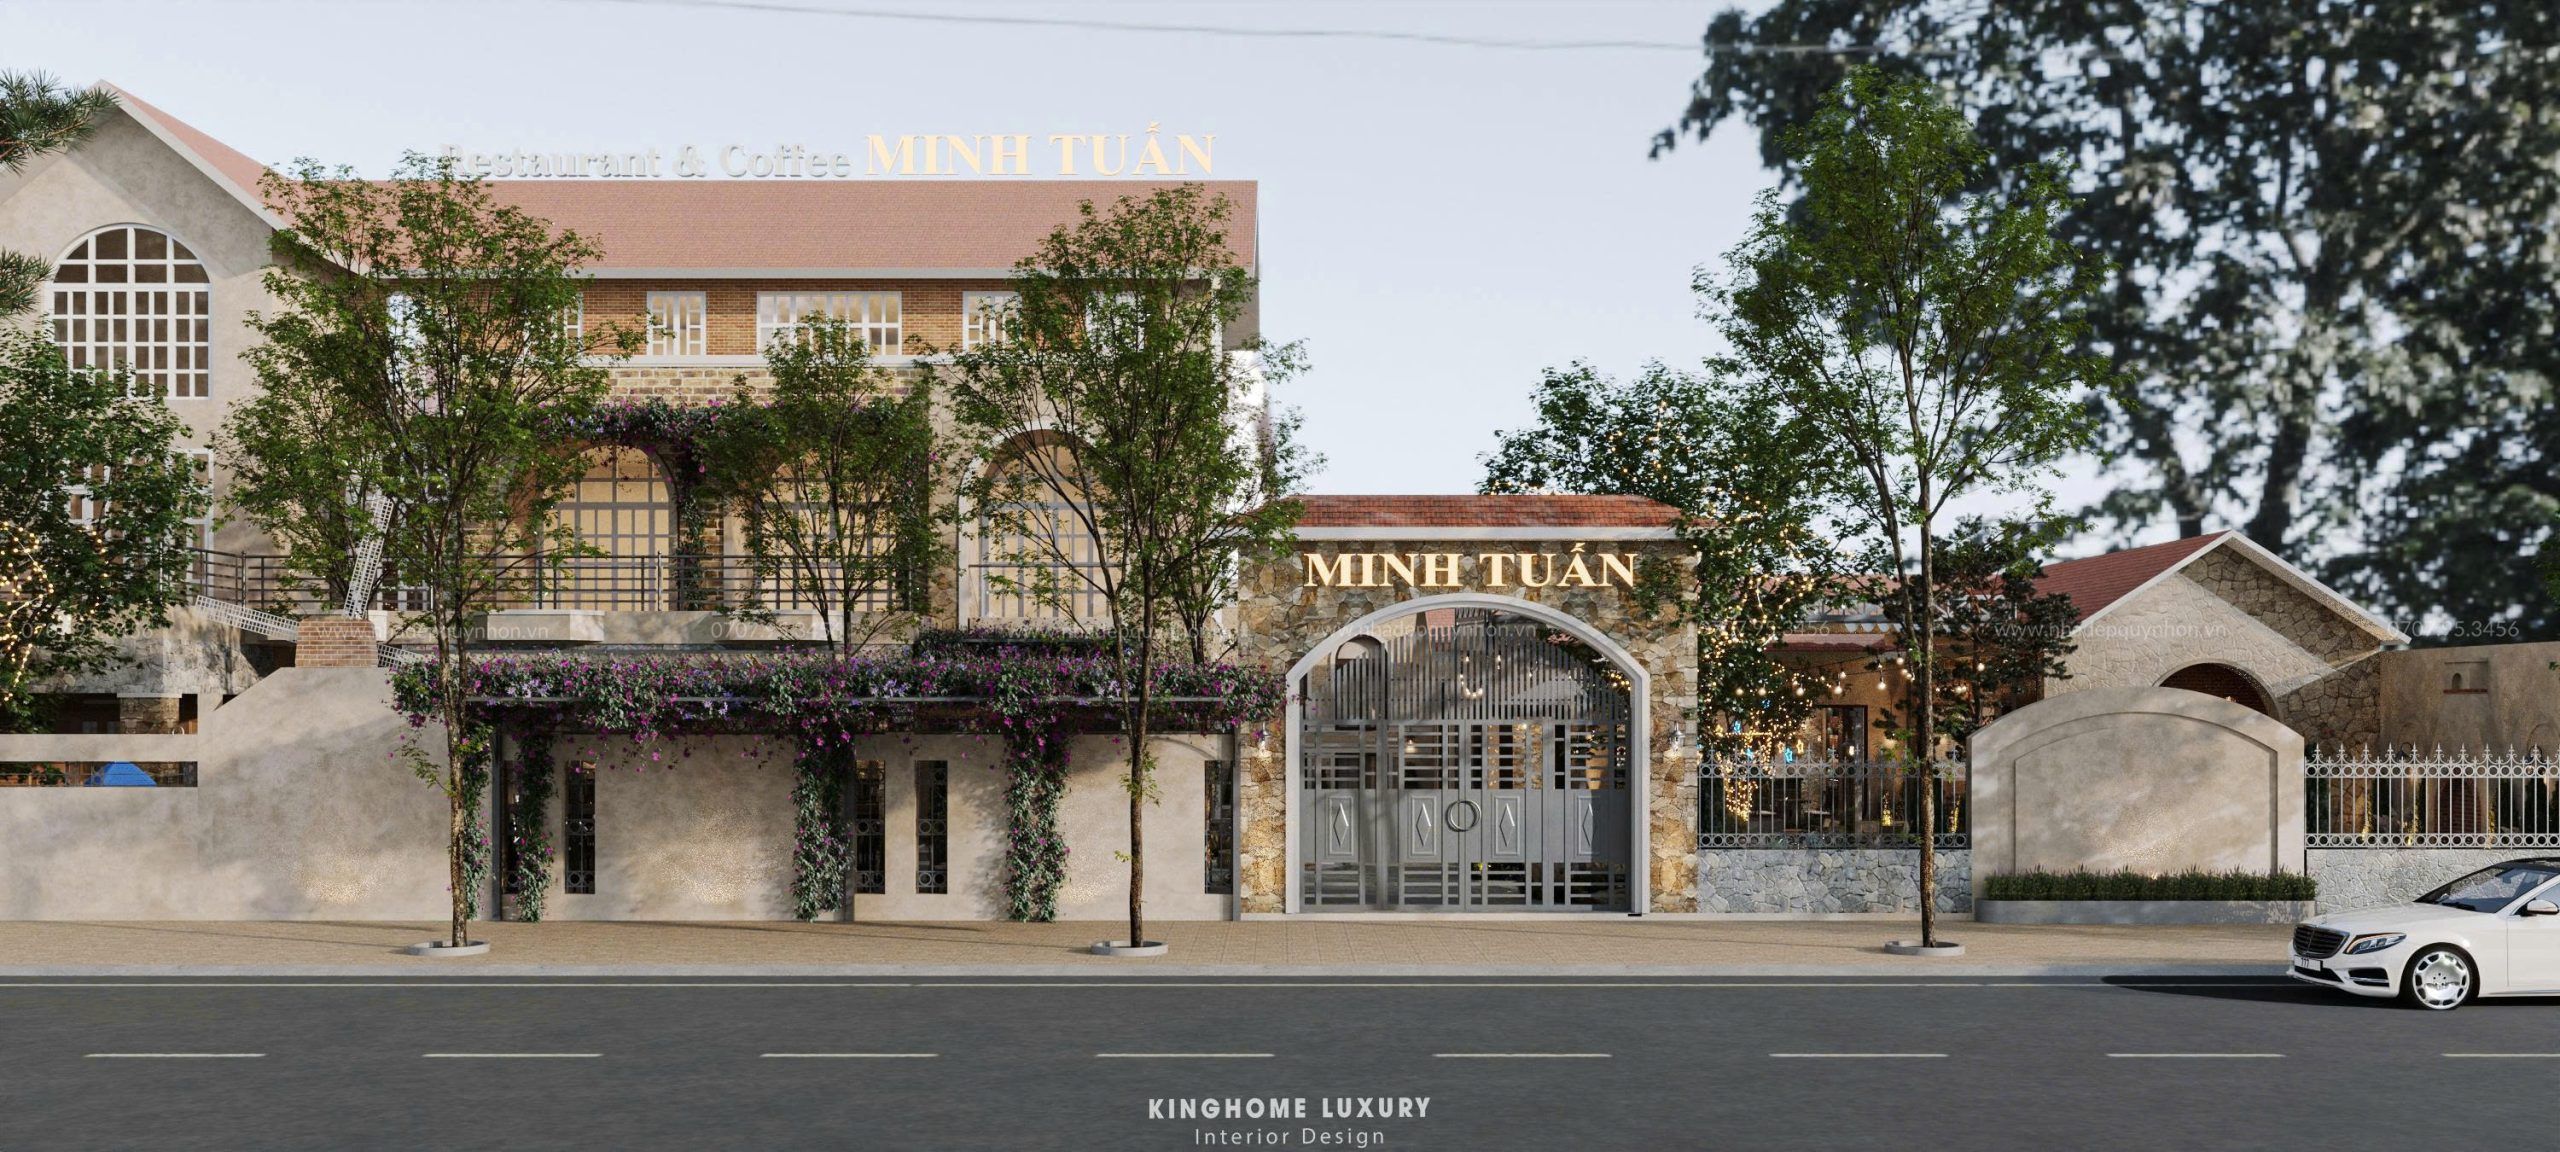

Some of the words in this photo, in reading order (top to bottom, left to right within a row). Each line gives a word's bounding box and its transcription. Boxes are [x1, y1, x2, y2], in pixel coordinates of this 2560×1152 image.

[441, 142, 663, 178] Restaurant
[672, 144, 707, 178] &
[720, 144, 850, 178] Coffee
[865, 133, 1033, 176] MINH
[1050, 121, 1217, 177] TUẤN
[1303, 553, 1464, 587] MINH
[1479, 542, 1639, 587] TUẤN
